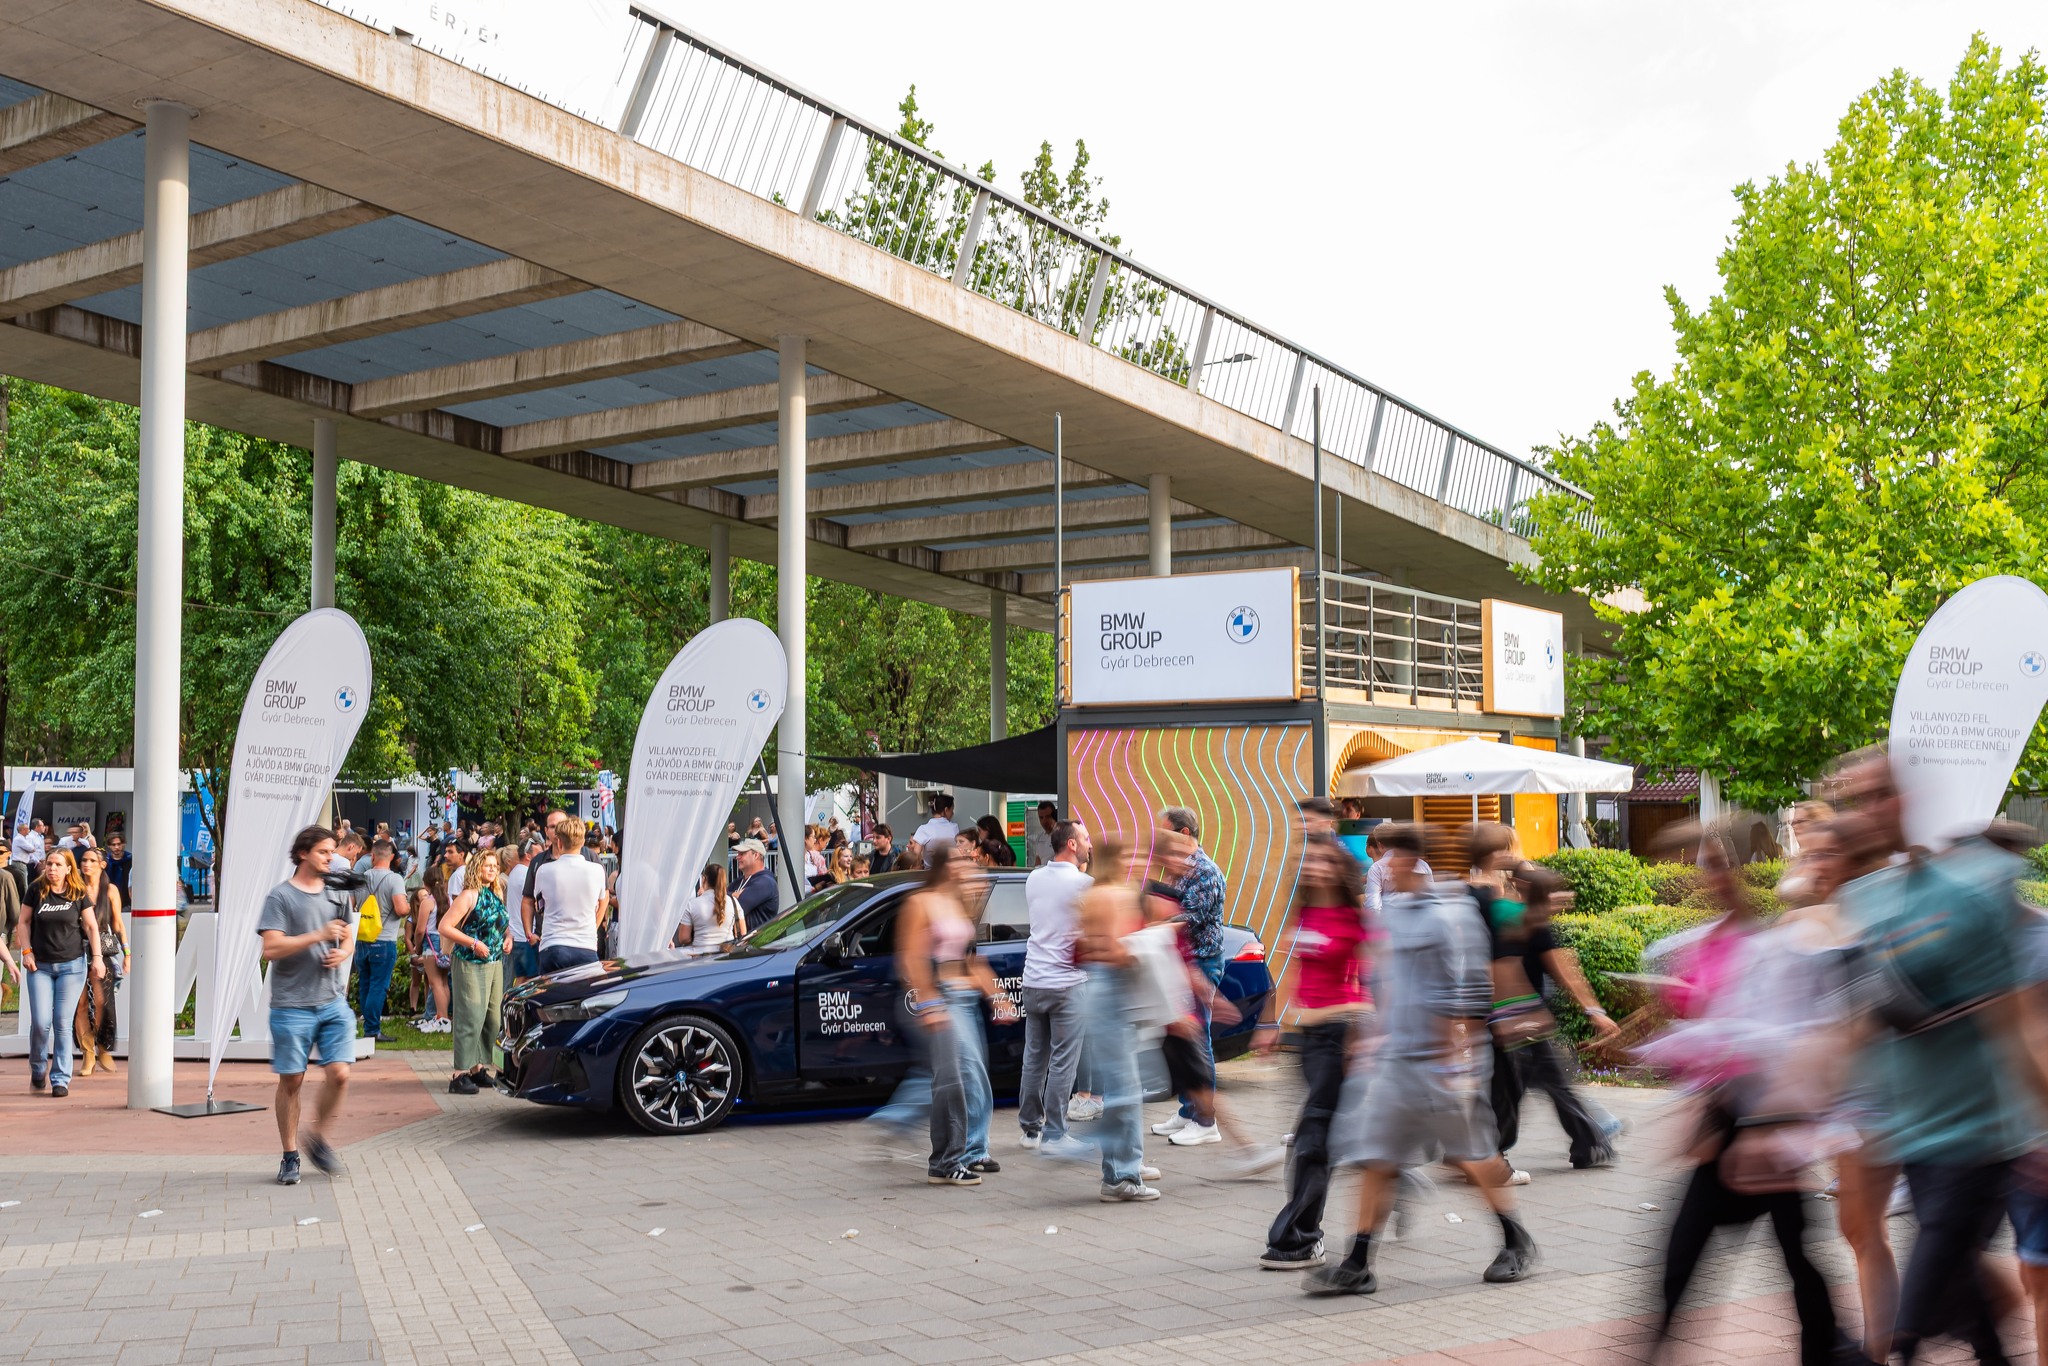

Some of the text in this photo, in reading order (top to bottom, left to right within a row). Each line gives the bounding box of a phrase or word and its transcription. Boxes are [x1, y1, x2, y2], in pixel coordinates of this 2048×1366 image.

[1100, 612, 1145, 632] BMW
[1100, 630, 1162, 650] GROUP
[1504, 632, 1520, 648] BMW
[1505, 649, 1525, 665] GROUP
[1930, 646, 1970, 660] BMW
[1100, 654, 1194, 672] Gyár Debrecen
[1928, 660, 1983, 675] GROUP
[266, 680, 298, 694] BMW
[669, 685, 706, 698] BMW
[1926, 678, 2009, 691] Gyár Debrecen
[264, 694, 306, 709] GROUP
[667, 698, 715, 712] GROUP
[262, 711, 325, 726] Gyár Debrecen
[665, 714, 736, 726] Gyár Debrecen
[1910, 711, 1990, 724] VILLANYOZD FEL
[1910, 724, 1916, 734] A
[1952, 727, 1959, 736] A
[1961, 726, 1985, 737] BMW
[1987, 727, 2021, 739] GROUP
[1909, 736, 2011, 752] GYÁR DEBRECENNÉL!
[248, 744, 307, 759] VILLANYOZD FEL
[648, 746, 717, 757] VILLANYOZD FEL
[246, 758, 251, 768] A
[277, 761, 283, 770] A
[284, 762, 303, 772] BMW
[304, 763, 330, 776] GROUP
[647, 758, 653, 767] A
[684, 760, 690, 769] A
[692, 760, 712, 769] BMW
[714, 760, 744, 771] GROUP
[1923, 756, 1987, 766] bmwgroup.jobs/hu
[31, 770, 86, 782] HALMS
[245, 770, 264, 782] GYÁR
[265, 774, 321, 788] DEBRECENNÉL!
[646, 769, 668, 780] GYÁR
[992, 977, 1023, 989] TARTS
[818, 991, 850, 1007] BMW
[993, 992, 1006, 1004] AZ
[820, 1005, 862, 1020] GROUP
[821, 1022, 886, 1036] Gyár Debrecen
